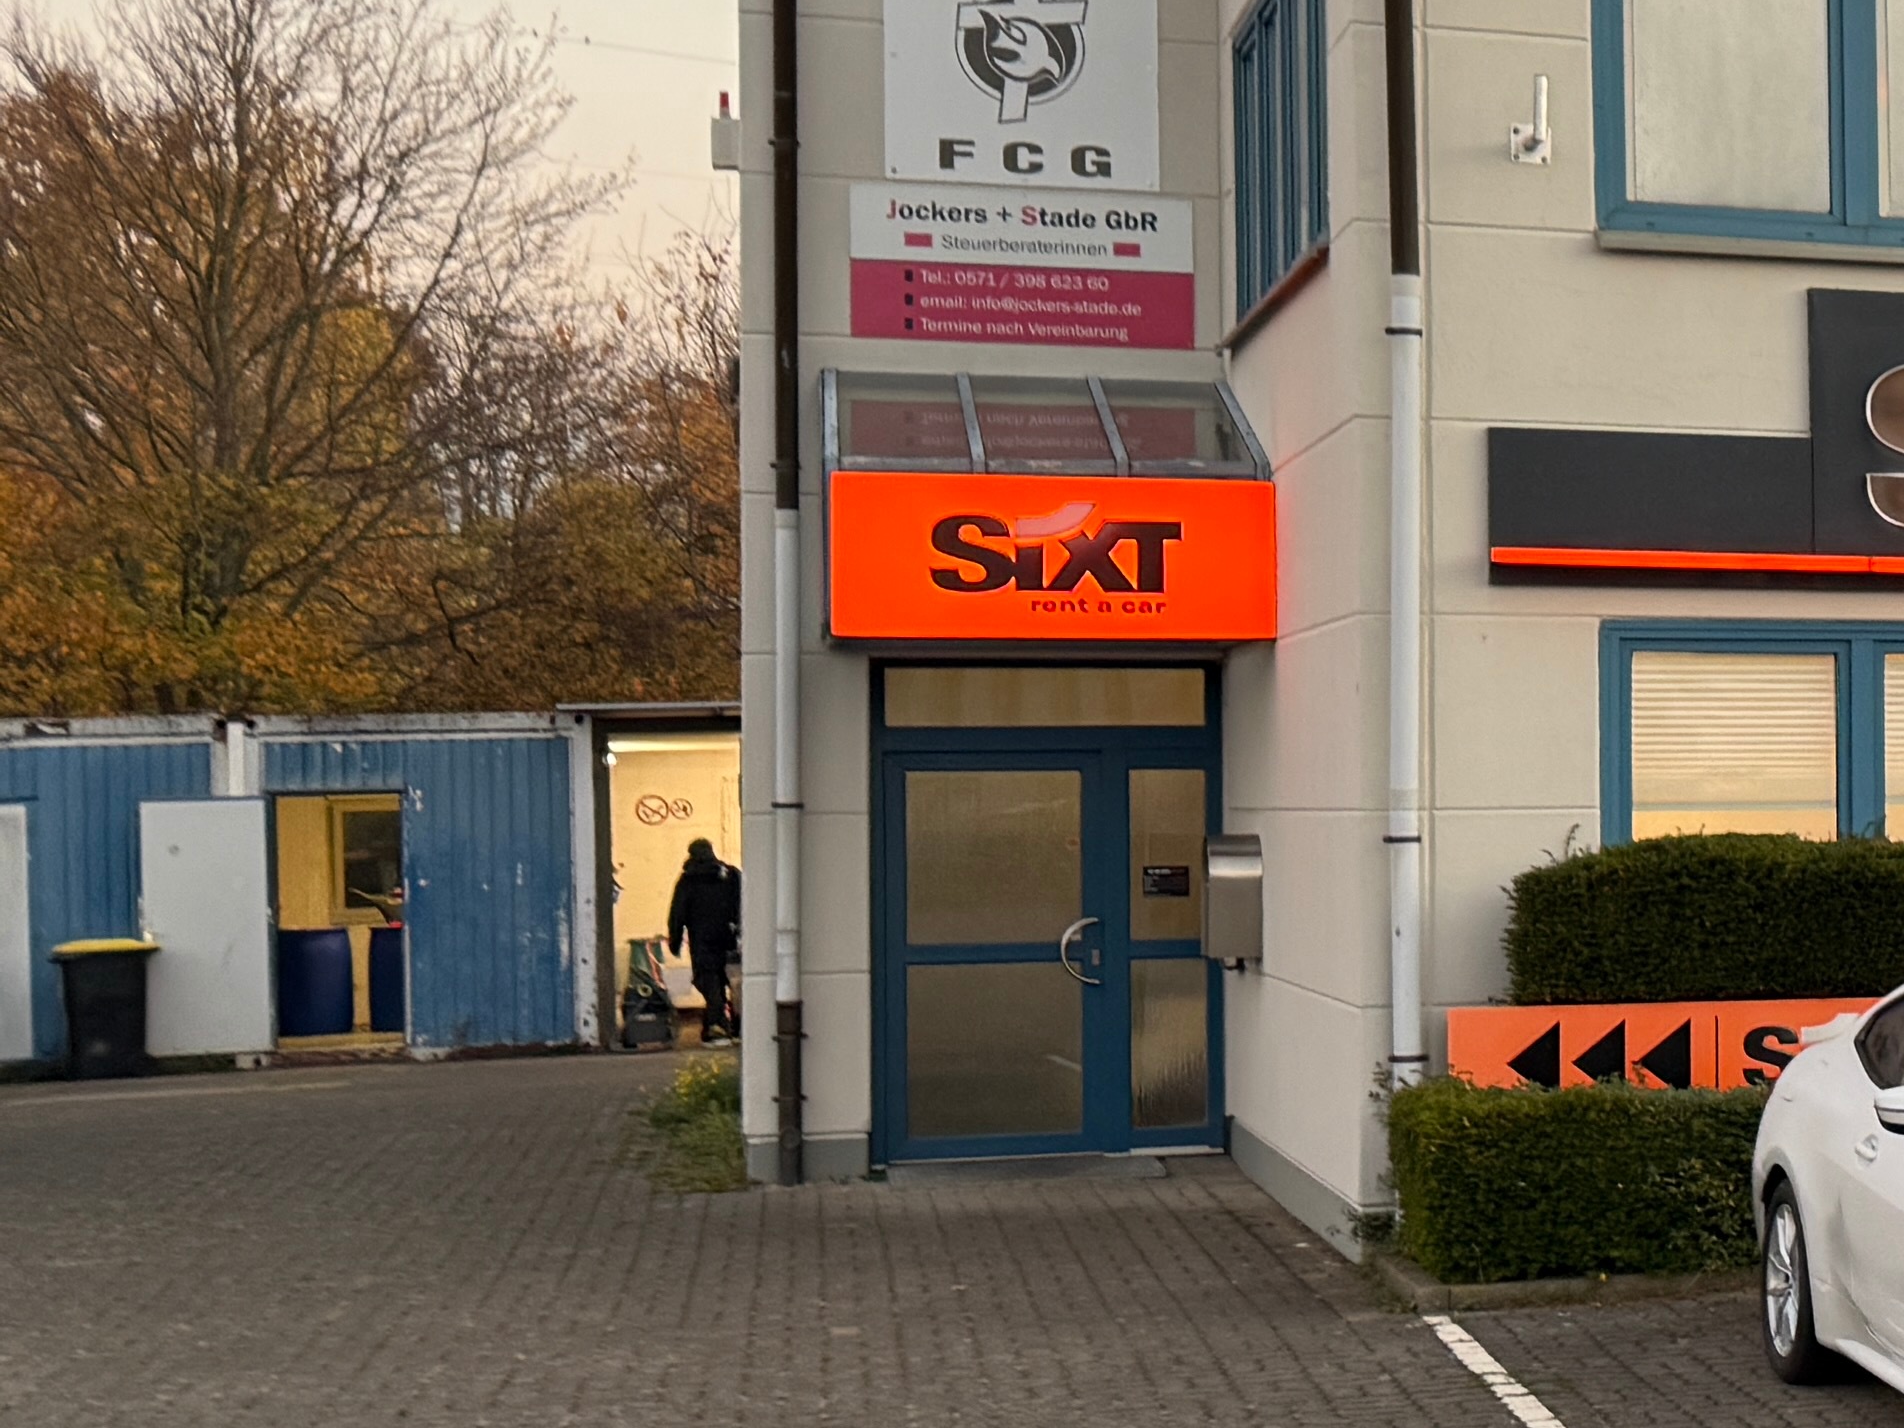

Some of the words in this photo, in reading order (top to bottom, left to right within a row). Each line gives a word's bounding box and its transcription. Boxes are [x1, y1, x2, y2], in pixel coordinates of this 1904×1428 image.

[886, 198, 987, 224] Jockers
[1021, 205, 1096, 229] Stade
[1105, 210, 1158, 232] GbR
[942, 234, 1108, 256] Steuerberaterinnen
[955, 271, 996, 286] 0571
[1051, 274, 1083, 290] 623
[1087, 276, 1109, 291] 60
[921, 296, 967, 309] email:
[921, 317, 982, 334] Termine
[986, 321, 1024, 335] nach
[1028, 322, 1129, 342] Vereinbarung
[1031, 598, 1088, 613] rent
[1098, 600, 1112, 613] a
[1121, 600, 1167, 614] car
